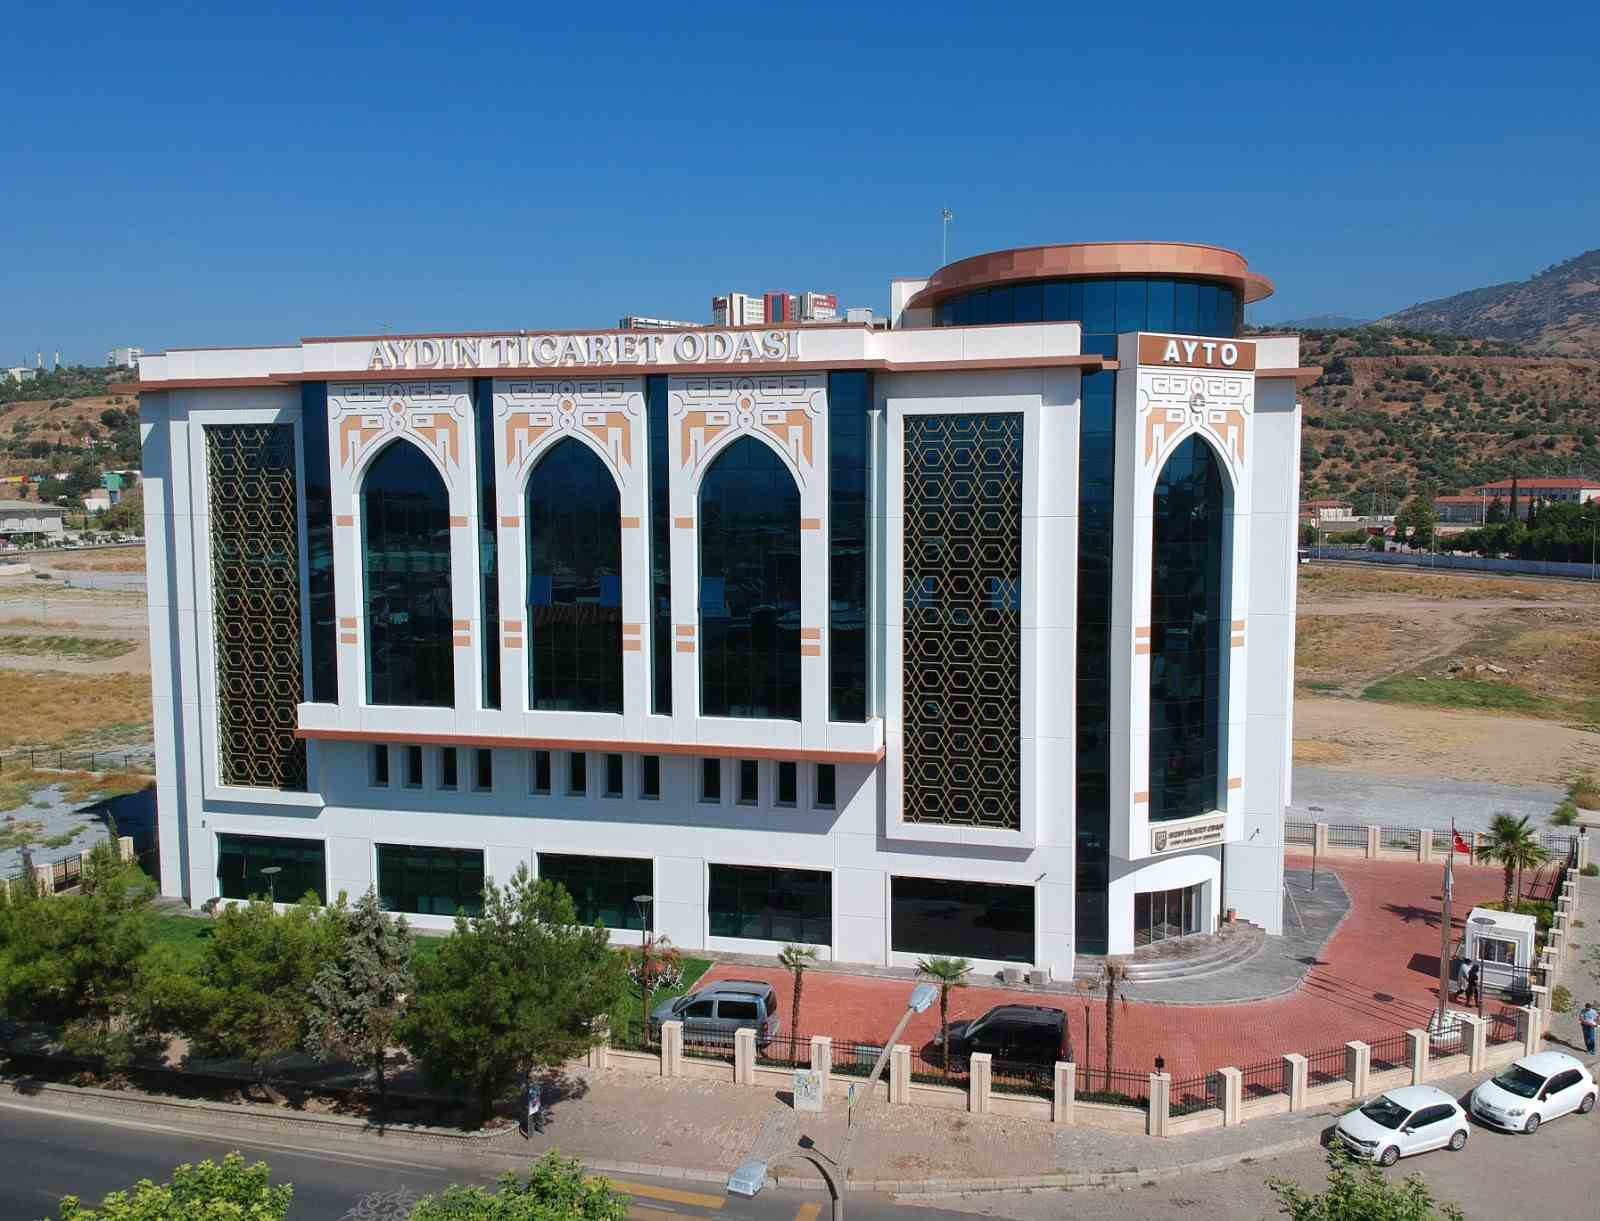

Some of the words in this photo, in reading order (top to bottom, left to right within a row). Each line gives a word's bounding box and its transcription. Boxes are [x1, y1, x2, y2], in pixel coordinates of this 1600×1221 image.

[368, 337, 481, 369] AYDIN
[490, 329, 663, 367] TİCARET
[673, 329, 800, 363] ODASI
[1162, 340, 1238, 366] AYTO
